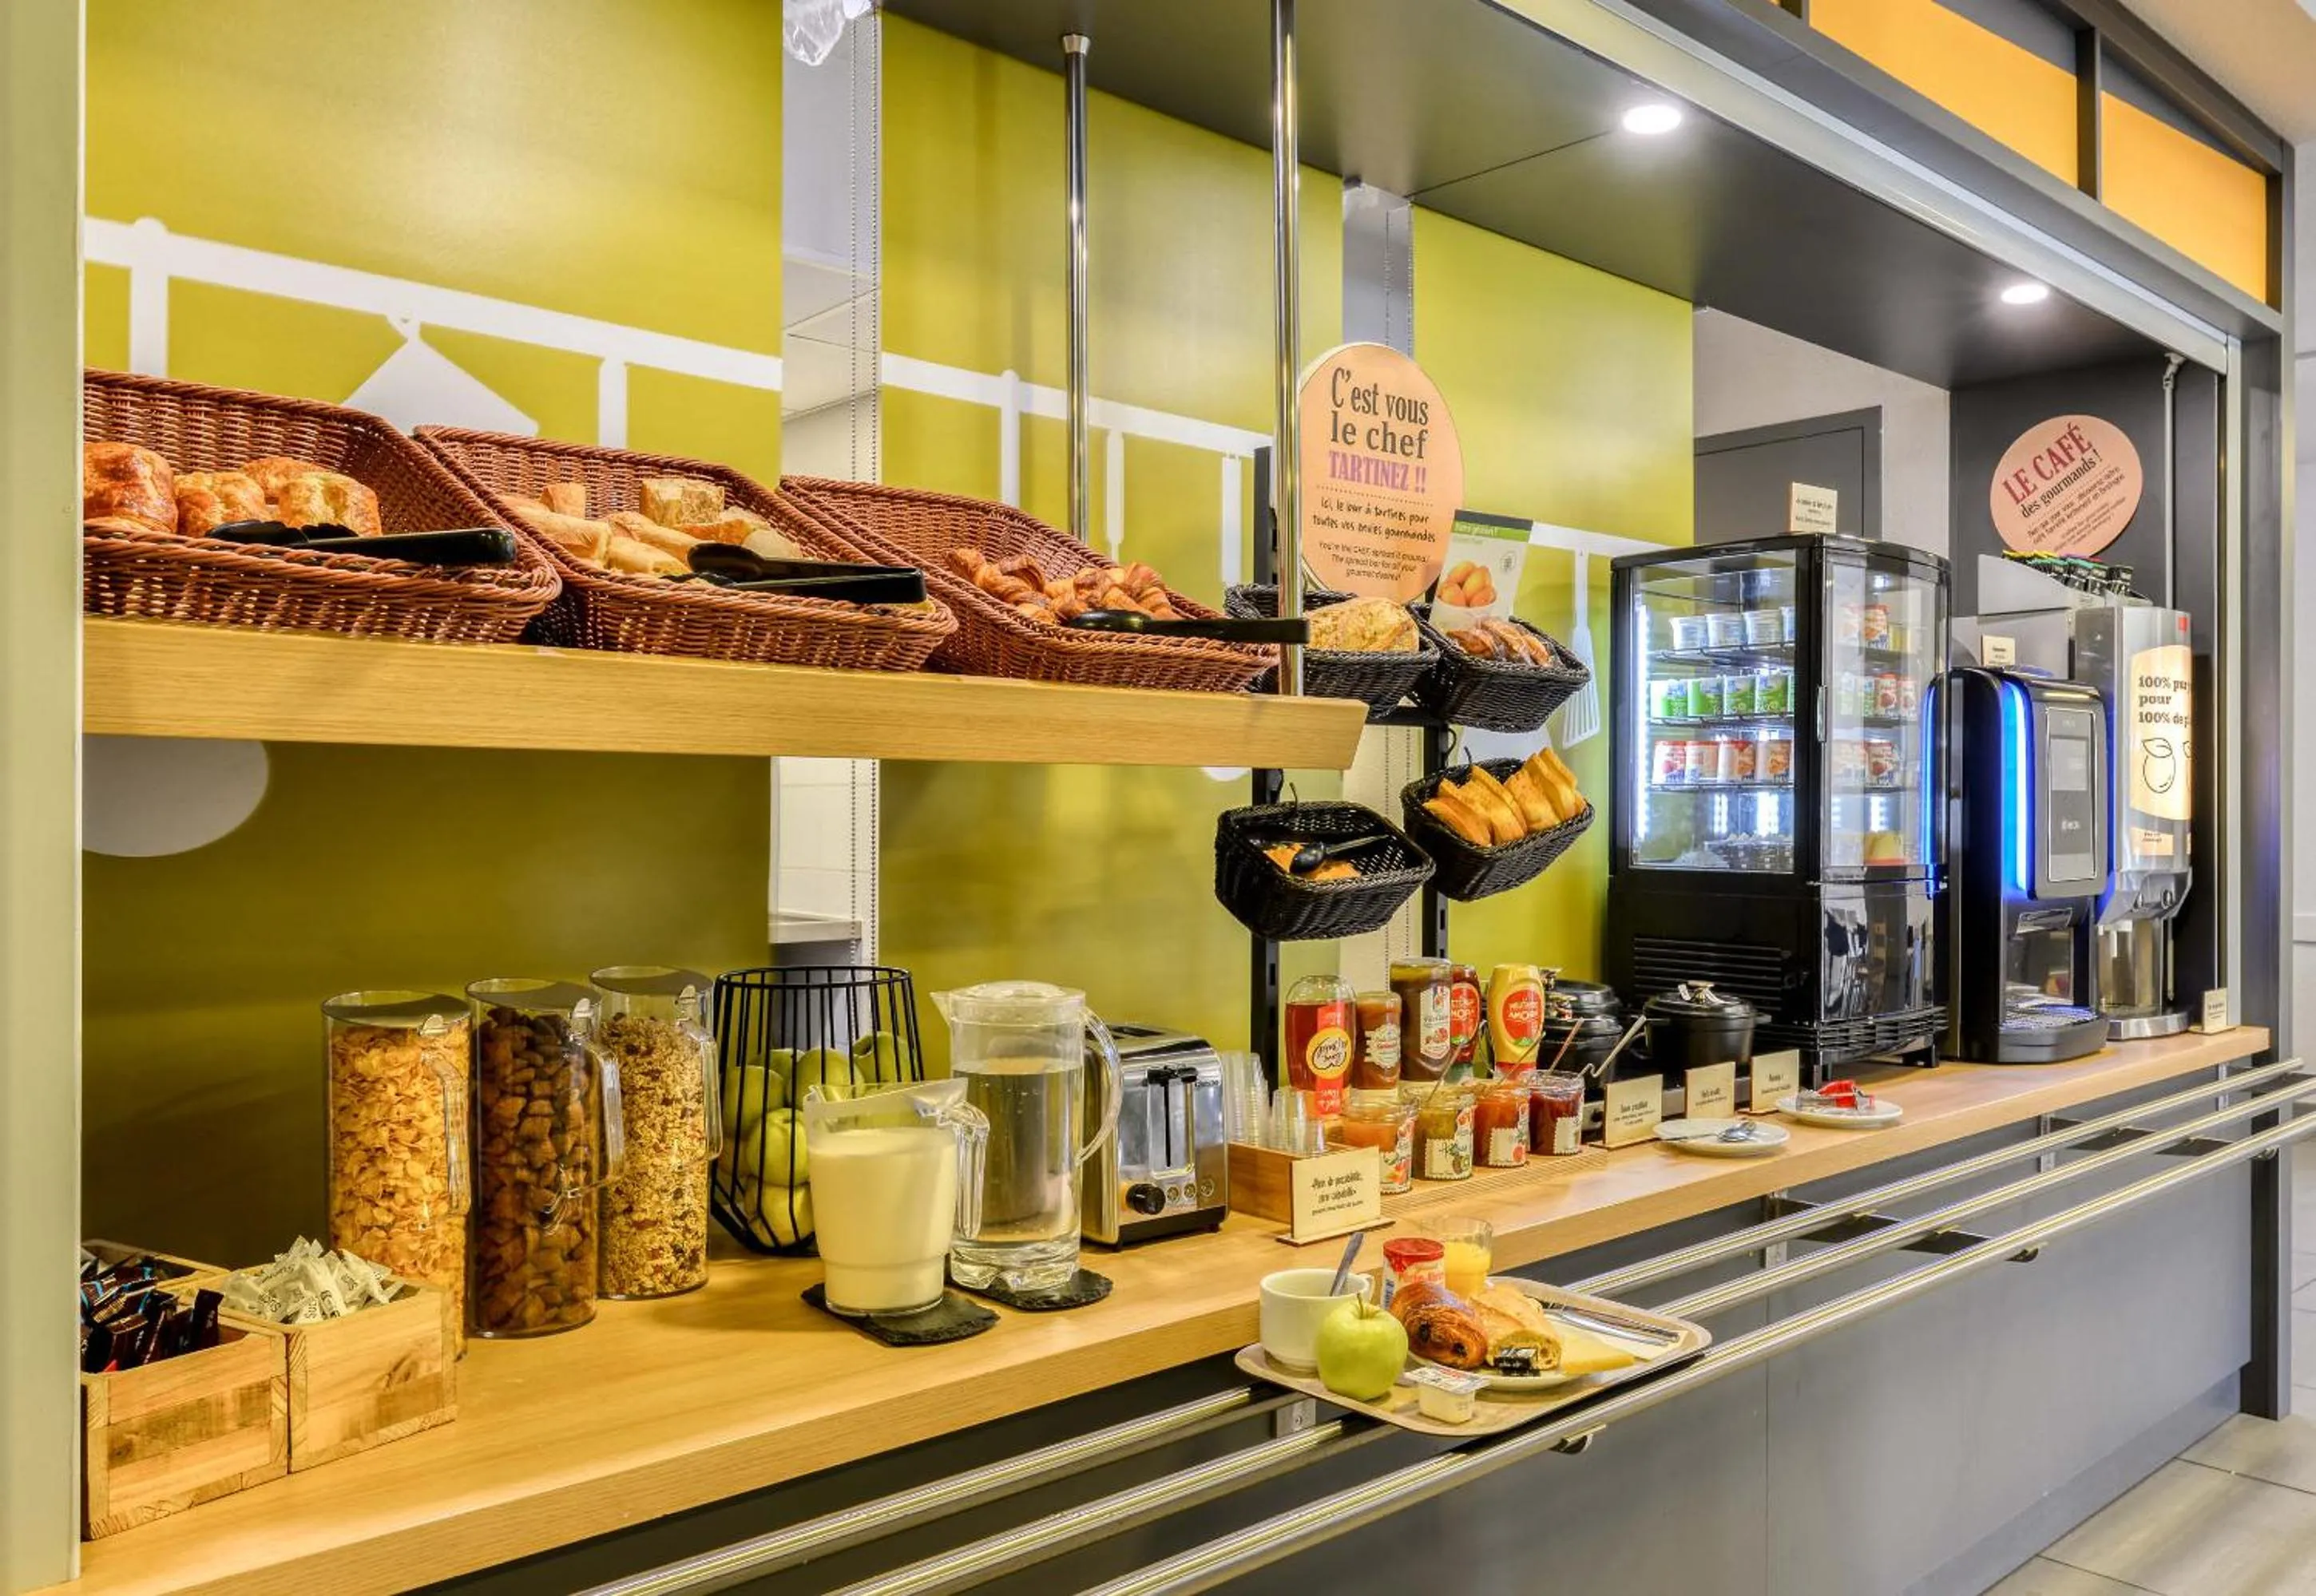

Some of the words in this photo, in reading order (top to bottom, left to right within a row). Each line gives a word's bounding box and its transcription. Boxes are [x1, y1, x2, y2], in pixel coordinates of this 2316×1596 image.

[1331, 366, 1379, 416] C'est
[1385, 394, 1429, 426] vous
[1331, 410, 1357, 446] le
[1366, 421, 1429, 459] chef
[1329, 450, 1410, 492] TARTINEZ
[1414, 465, 1426, 494] !!
[2002, 468, 2038, 505] LE
[2032, 422, 2093, 481] CAFÉ
[2021, 500, 2040, 518] des
[2040, 456, 2097, 508] gourmands
[1336, 498, 1344, 512] le
[1365, 501, 1371, 515] à
[1374, 505, 1406, 521] tartines
[1409, 513, 1430, 526] pour
[1341, 520, 1355, 532] vos
[1358, 523, 1382, 536] envies
[1384, 526, 1436, 543] gourmandes
[2139, 675, 2171, 688] 100%
[2139, 695, 2171, 707] pour
[2139, 711, 2171, 724] 100%
